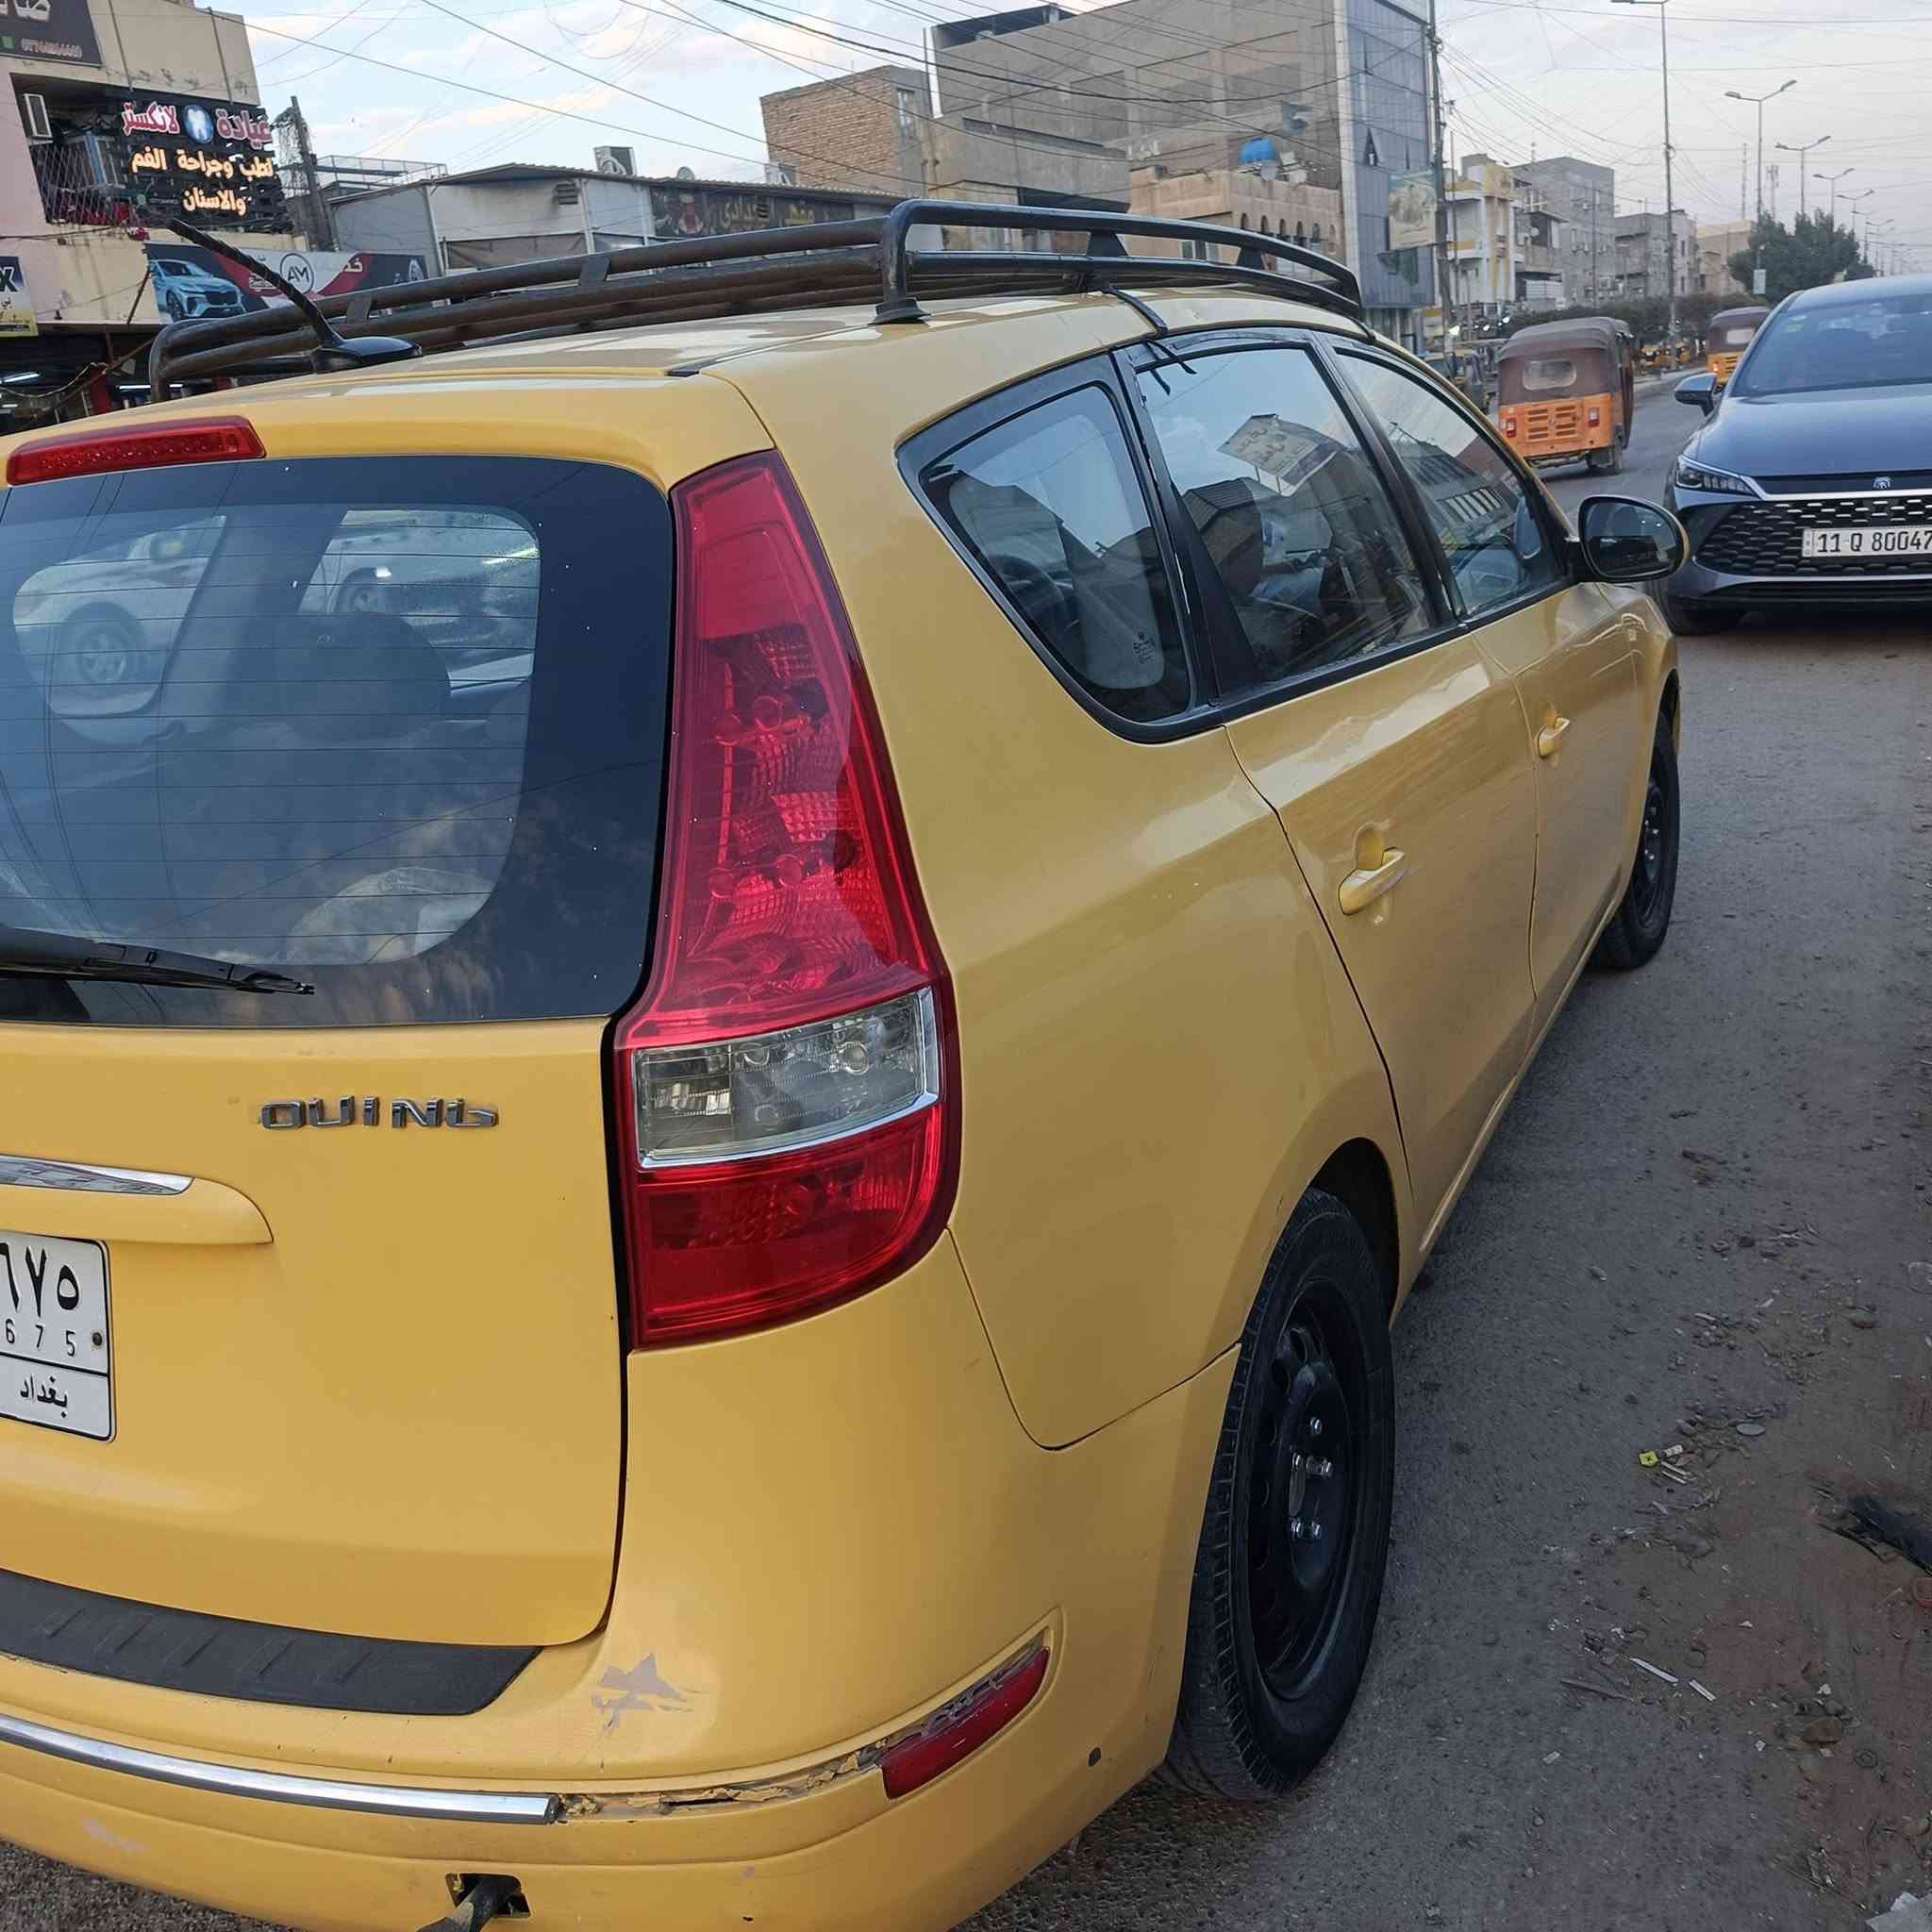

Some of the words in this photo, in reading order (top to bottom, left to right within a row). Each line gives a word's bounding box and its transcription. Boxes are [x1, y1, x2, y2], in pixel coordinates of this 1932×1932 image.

[215, 108, 273, 150] عيادة
[131, 145, 169, 174] الفم
[176, 148, 234, 180] وجراحة
[182, 187, 248, 217] والاسنان
[287, 264, 311, 284] AM
[1817, 533, 1840, 554] 11
[1850, 532, 1863, 552] Q
[1872, 530, 1932, 553] 80047
[20, 1375, 68, 1419] بغداد
